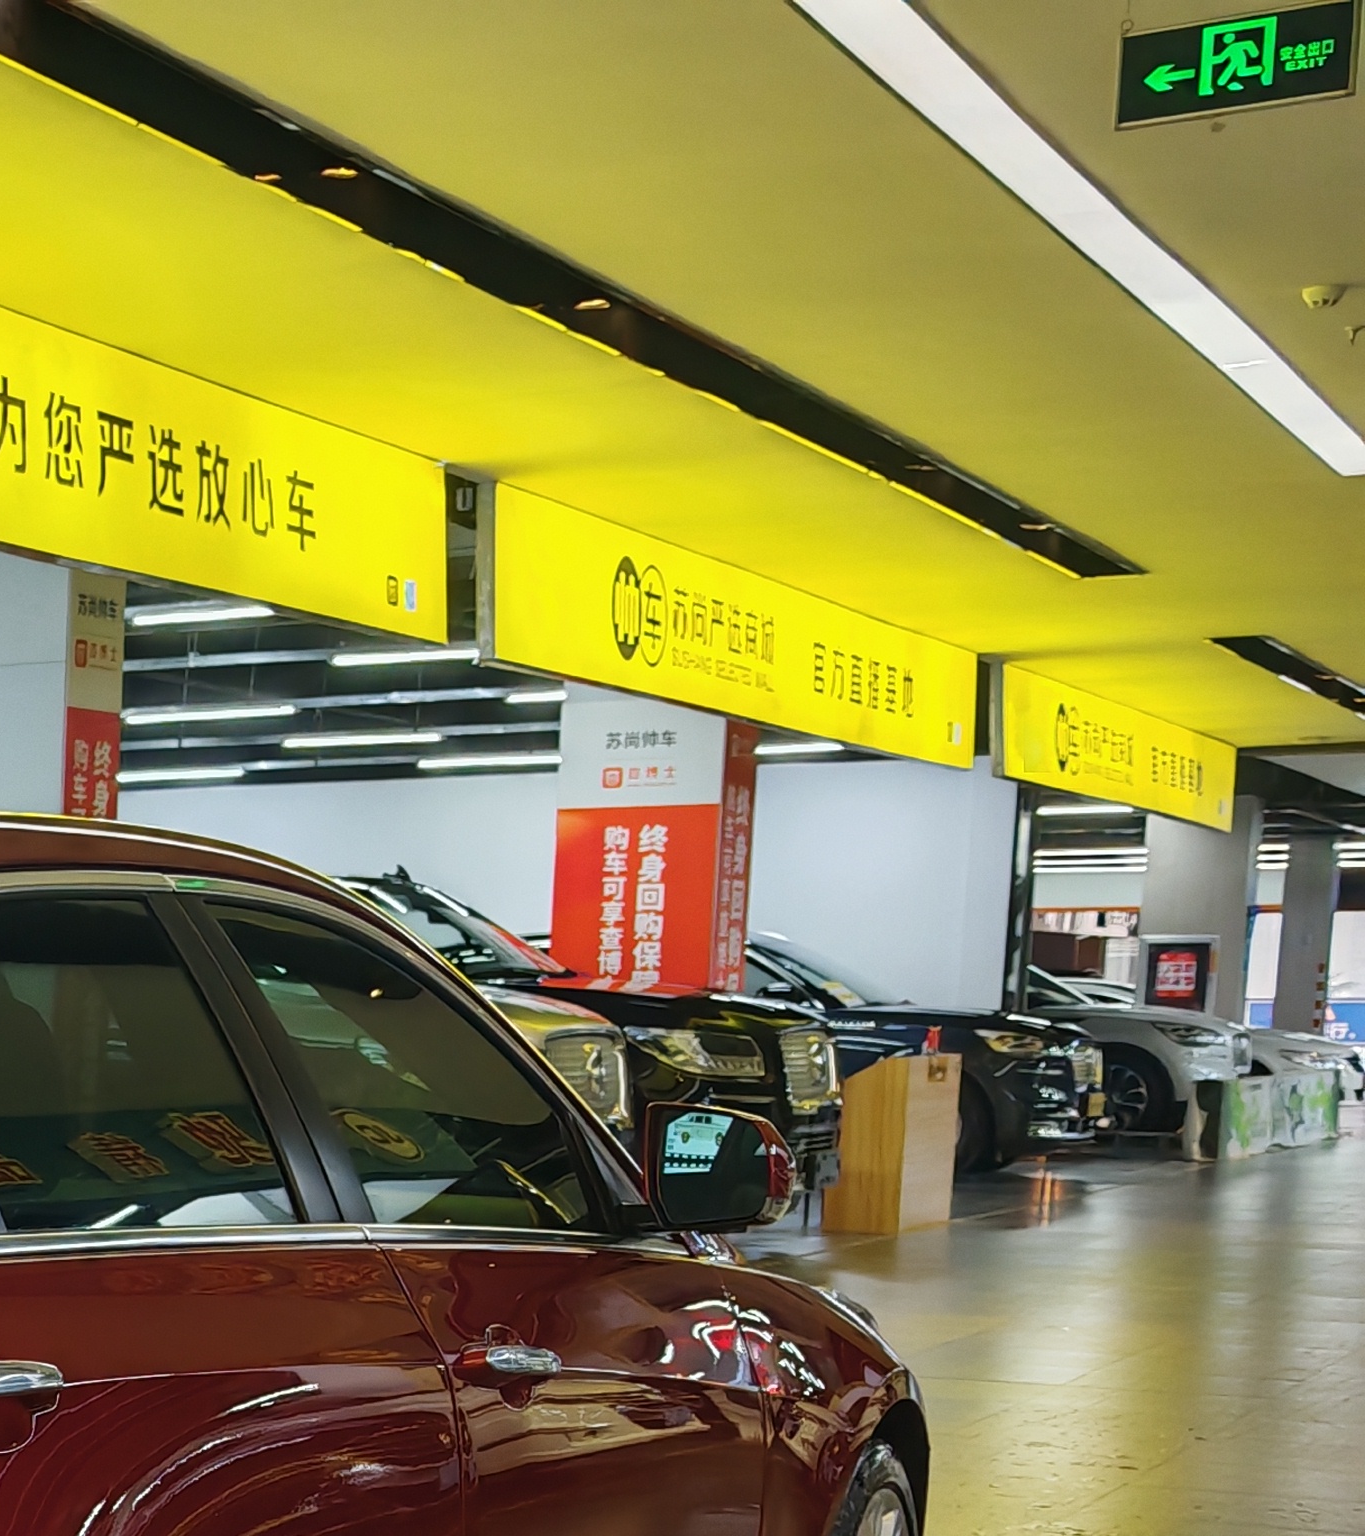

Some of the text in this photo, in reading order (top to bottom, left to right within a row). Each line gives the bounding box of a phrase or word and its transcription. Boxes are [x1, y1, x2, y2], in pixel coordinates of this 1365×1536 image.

[1279, 39, 1335, 62] 安全出口
[1284, 56, 1328, 72] EXIT
[604, 729, 678, 750] 苏尚帅车
[596, 825, 630, 982] 购车可享查博
